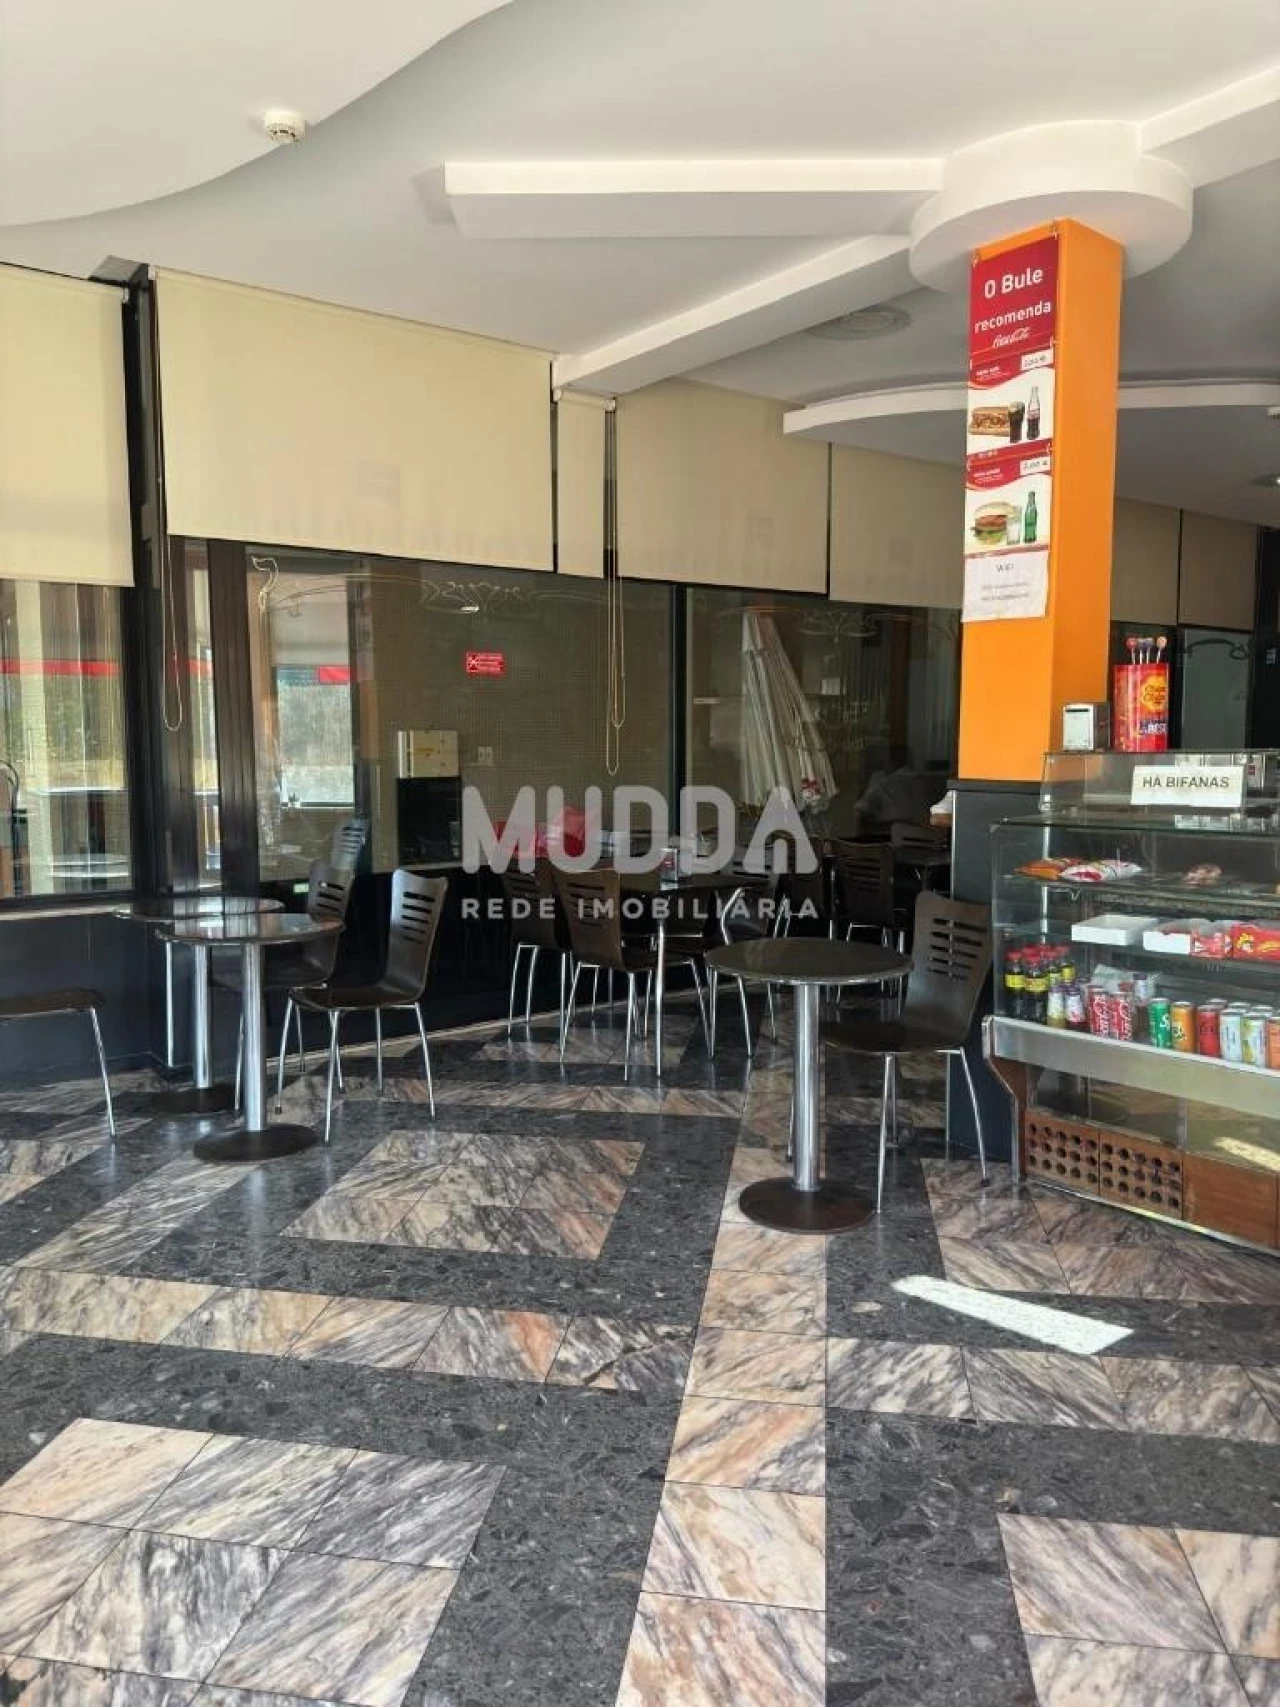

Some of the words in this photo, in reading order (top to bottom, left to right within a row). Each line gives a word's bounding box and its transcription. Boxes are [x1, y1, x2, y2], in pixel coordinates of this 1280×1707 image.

[1001, 267, 1044, 294] Bule
[974, 299, 1052, 334] recomenda
[1166, 776, 1230, 789] BIFANAS
